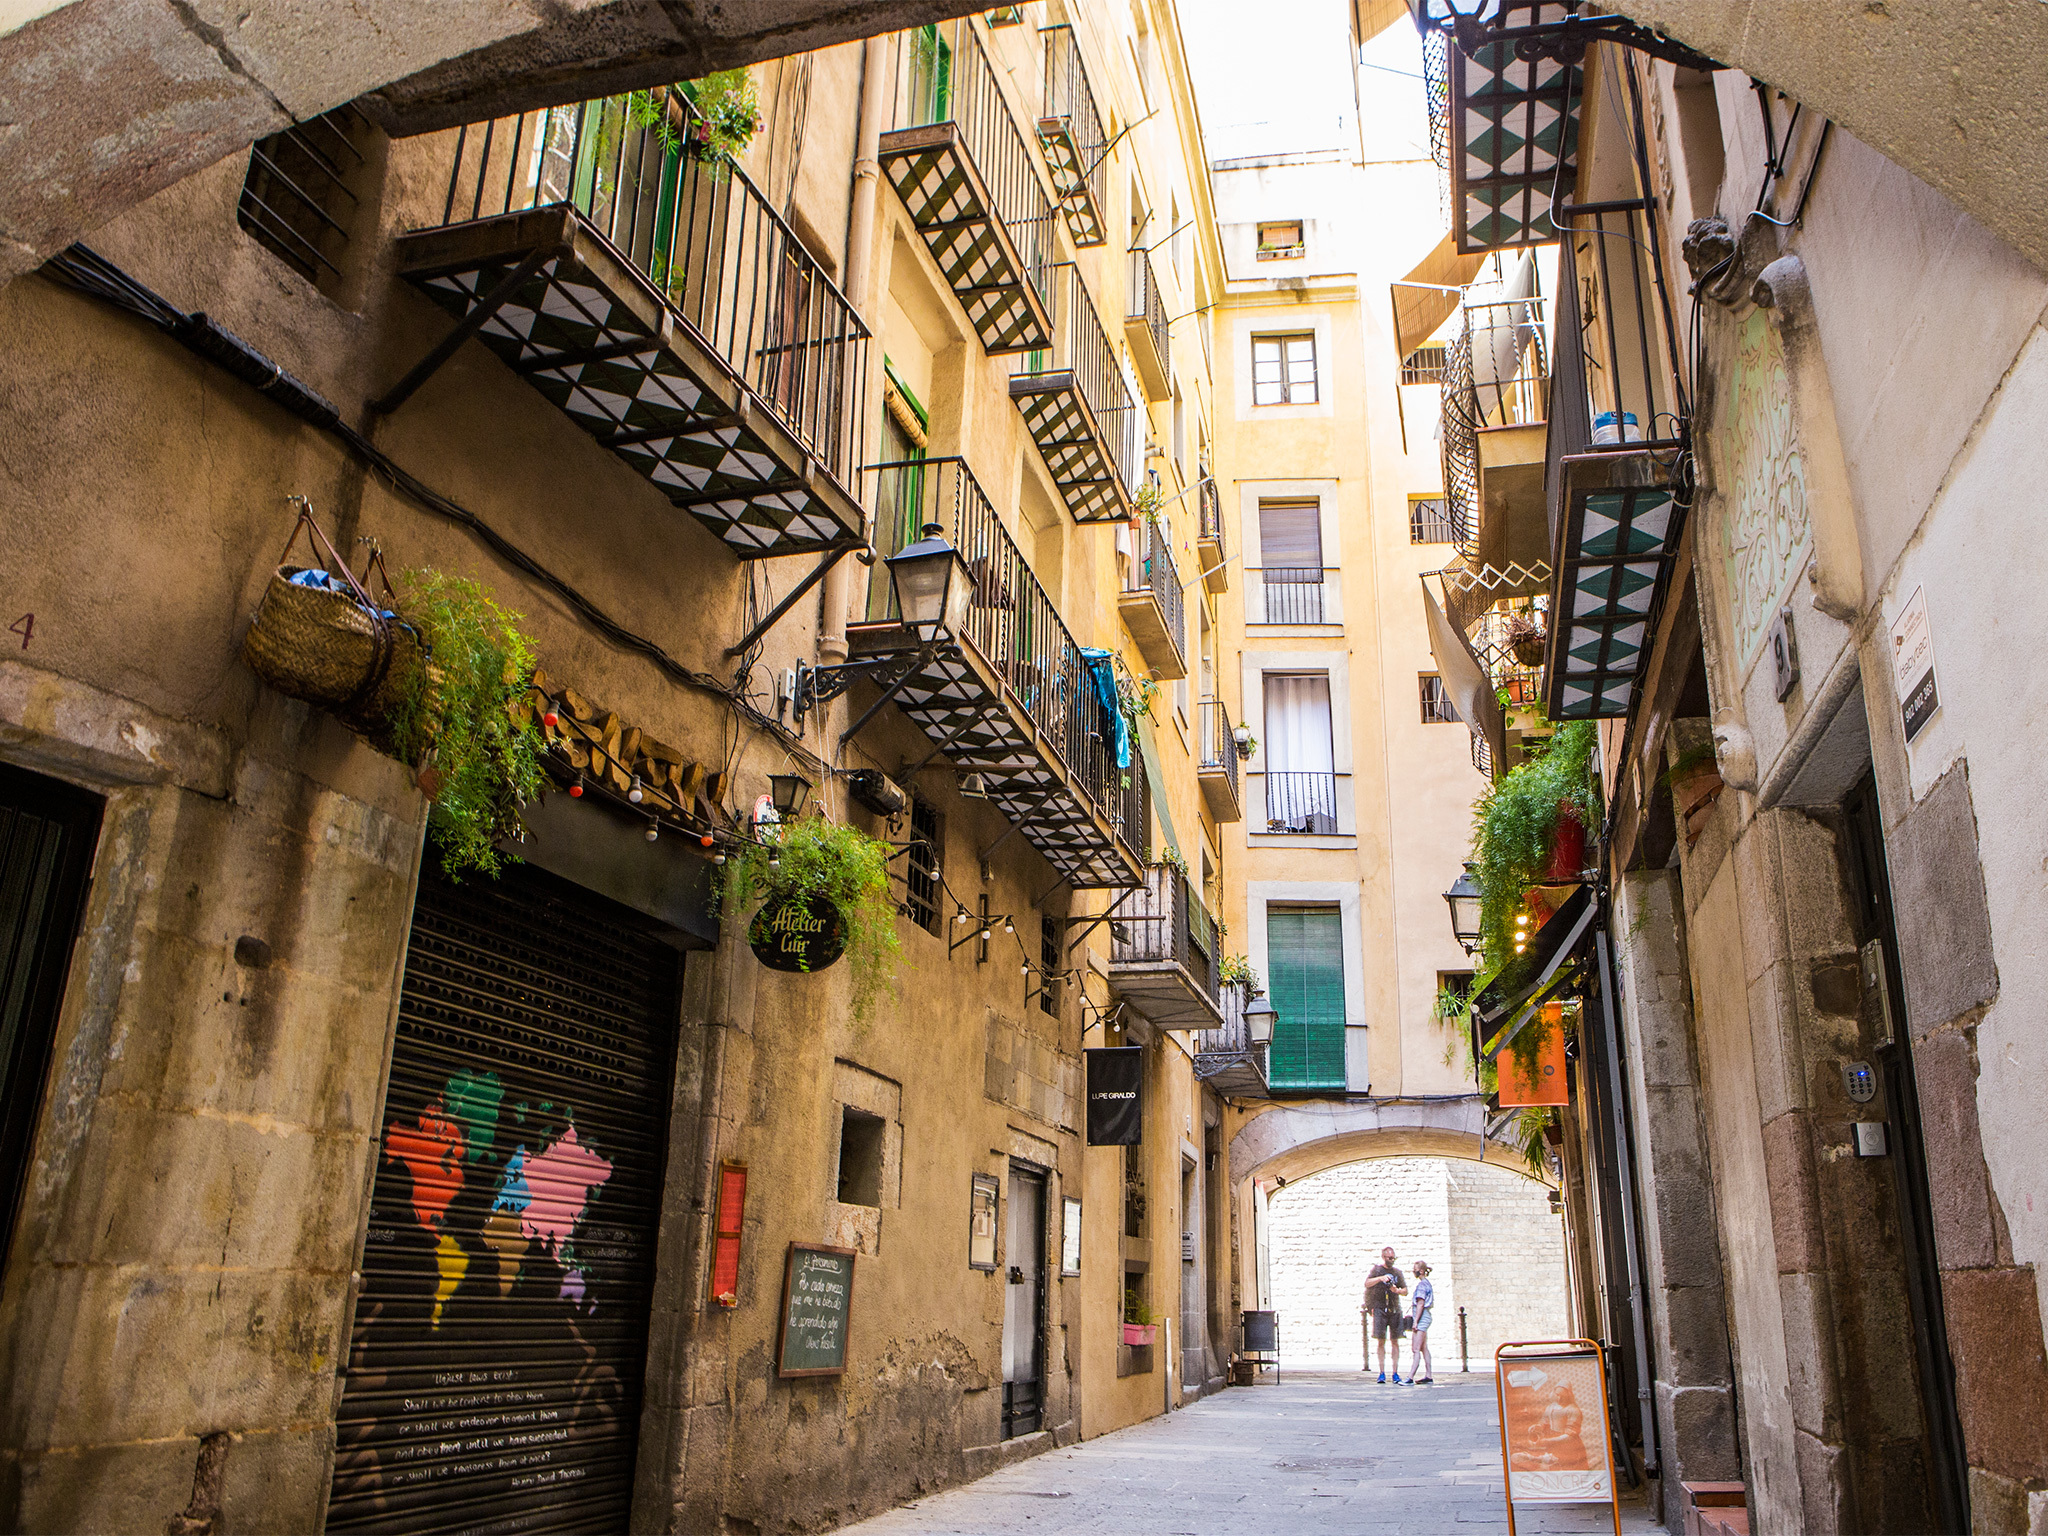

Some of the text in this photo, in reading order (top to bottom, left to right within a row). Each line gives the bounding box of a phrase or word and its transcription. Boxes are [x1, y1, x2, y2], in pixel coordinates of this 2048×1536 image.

[9, 613, 34, 649] 4
[1775, 633, 1783, 674] 9
[771, 906, 826, 934] Atelier
[1091, 1091, 1136, 1100] LUPE GIRALDO
